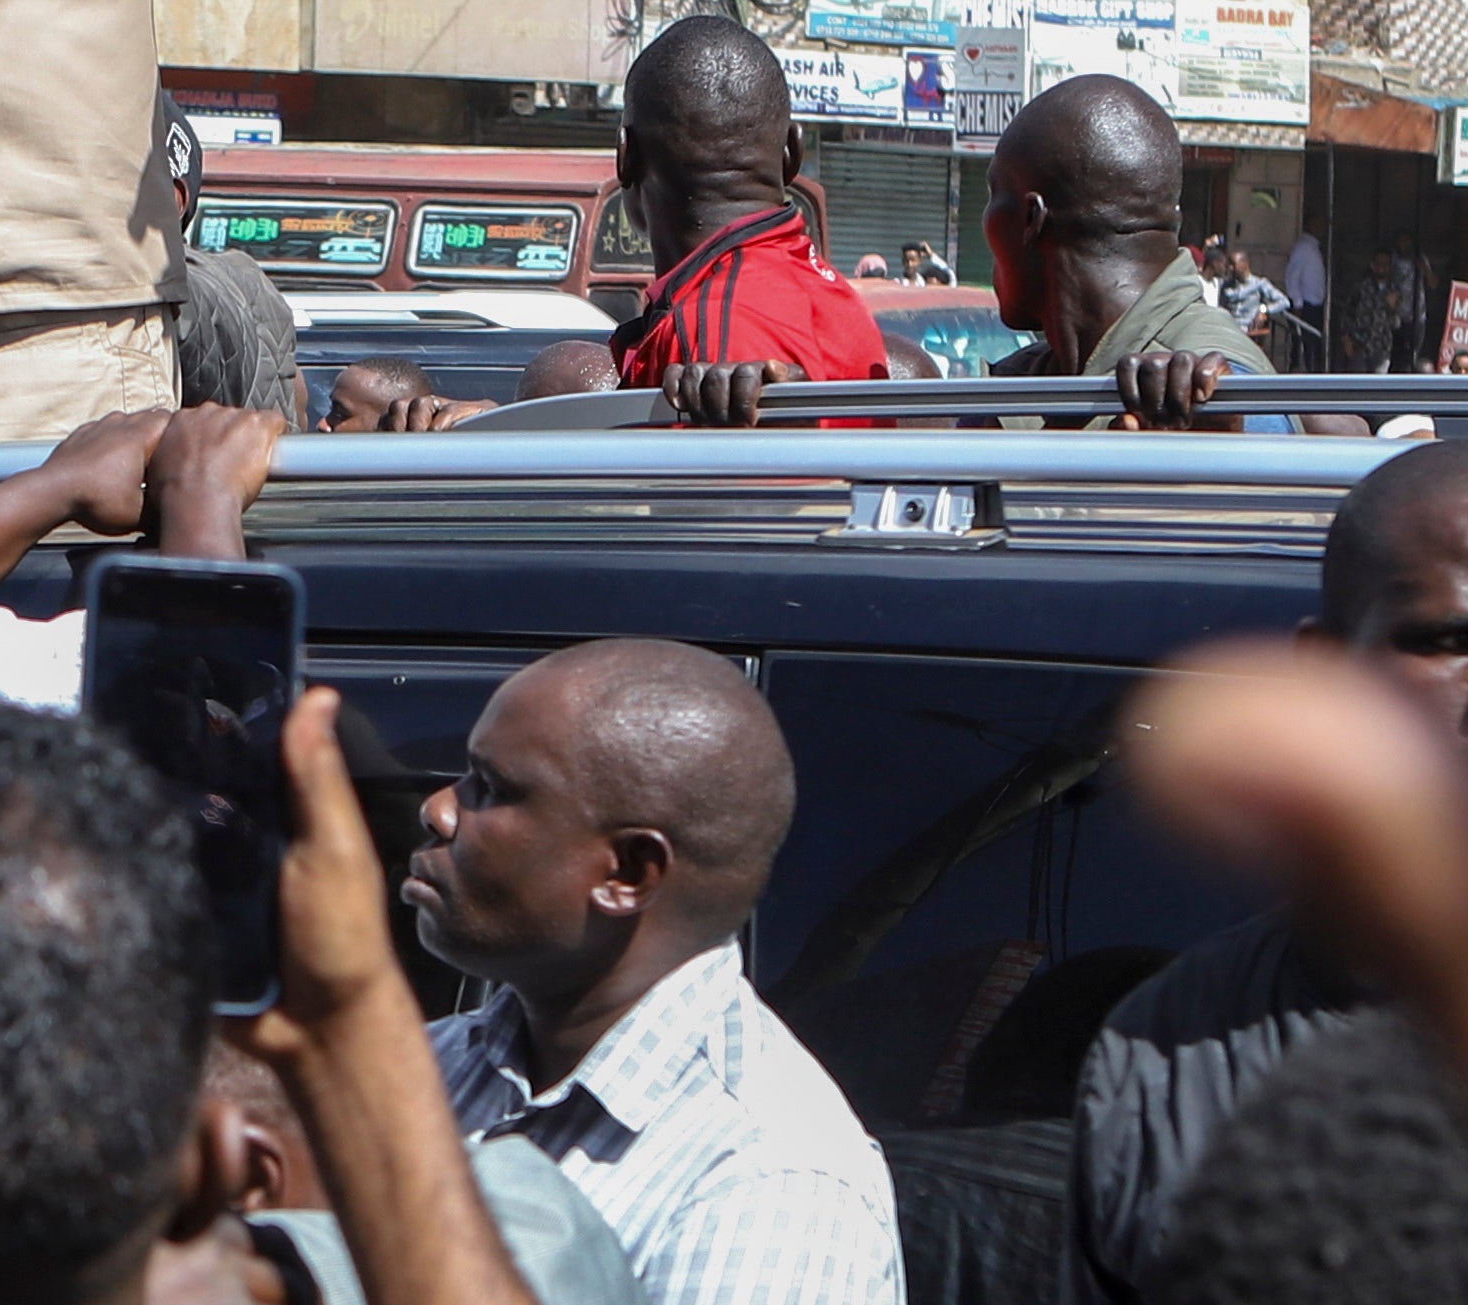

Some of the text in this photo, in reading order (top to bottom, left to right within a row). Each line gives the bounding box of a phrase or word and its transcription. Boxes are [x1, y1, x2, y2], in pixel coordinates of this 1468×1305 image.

[1268, 9, 1294, 27] BAY
[782, 59, 846, 78] ASH AIR
[788, 82, 839, 103] VICES
